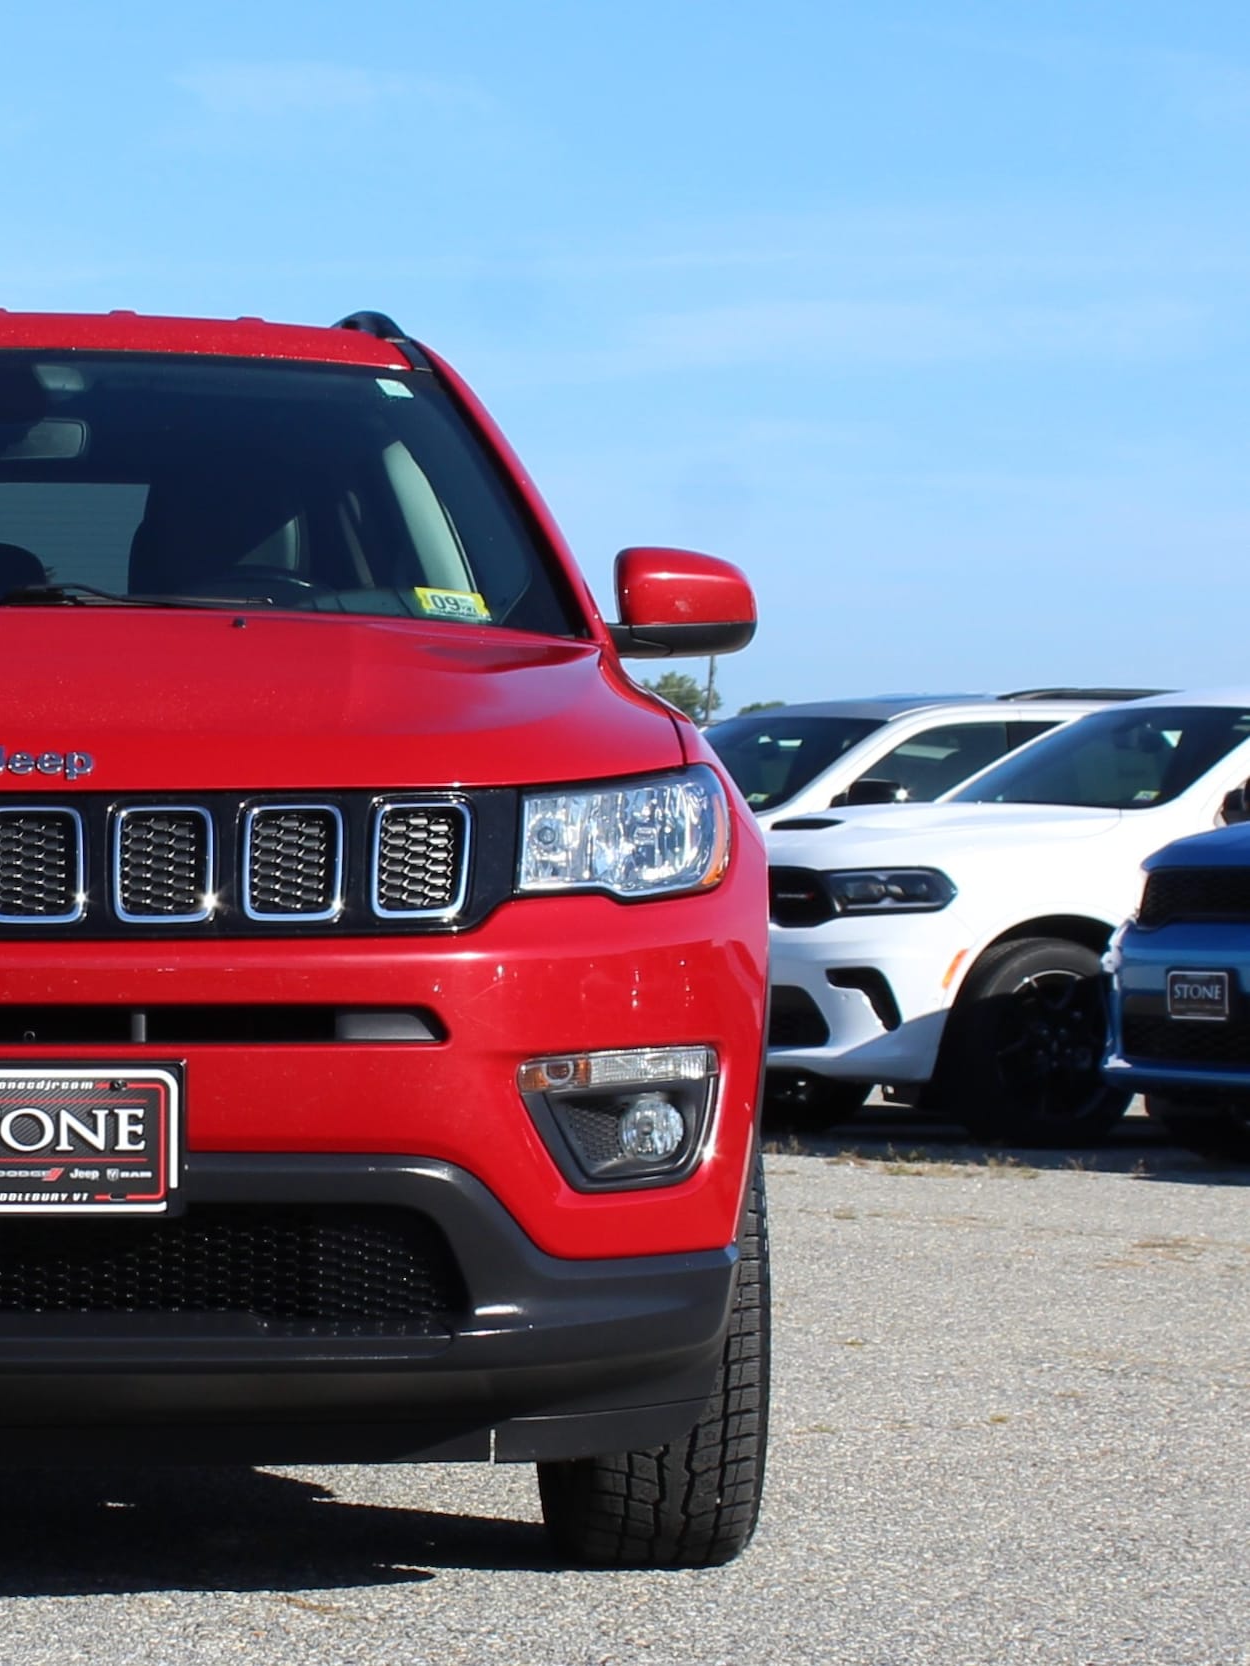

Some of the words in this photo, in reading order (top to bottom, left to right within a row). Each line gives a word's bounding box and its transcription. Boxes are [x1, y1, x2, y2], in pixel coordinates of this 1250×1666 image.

[430, 594, 460, 611] 09
[1174, 984, 1222, 1000] STONE
[69, 1168, 100, 1180] Jeep
[72, 1192, 89, 1202] VT
